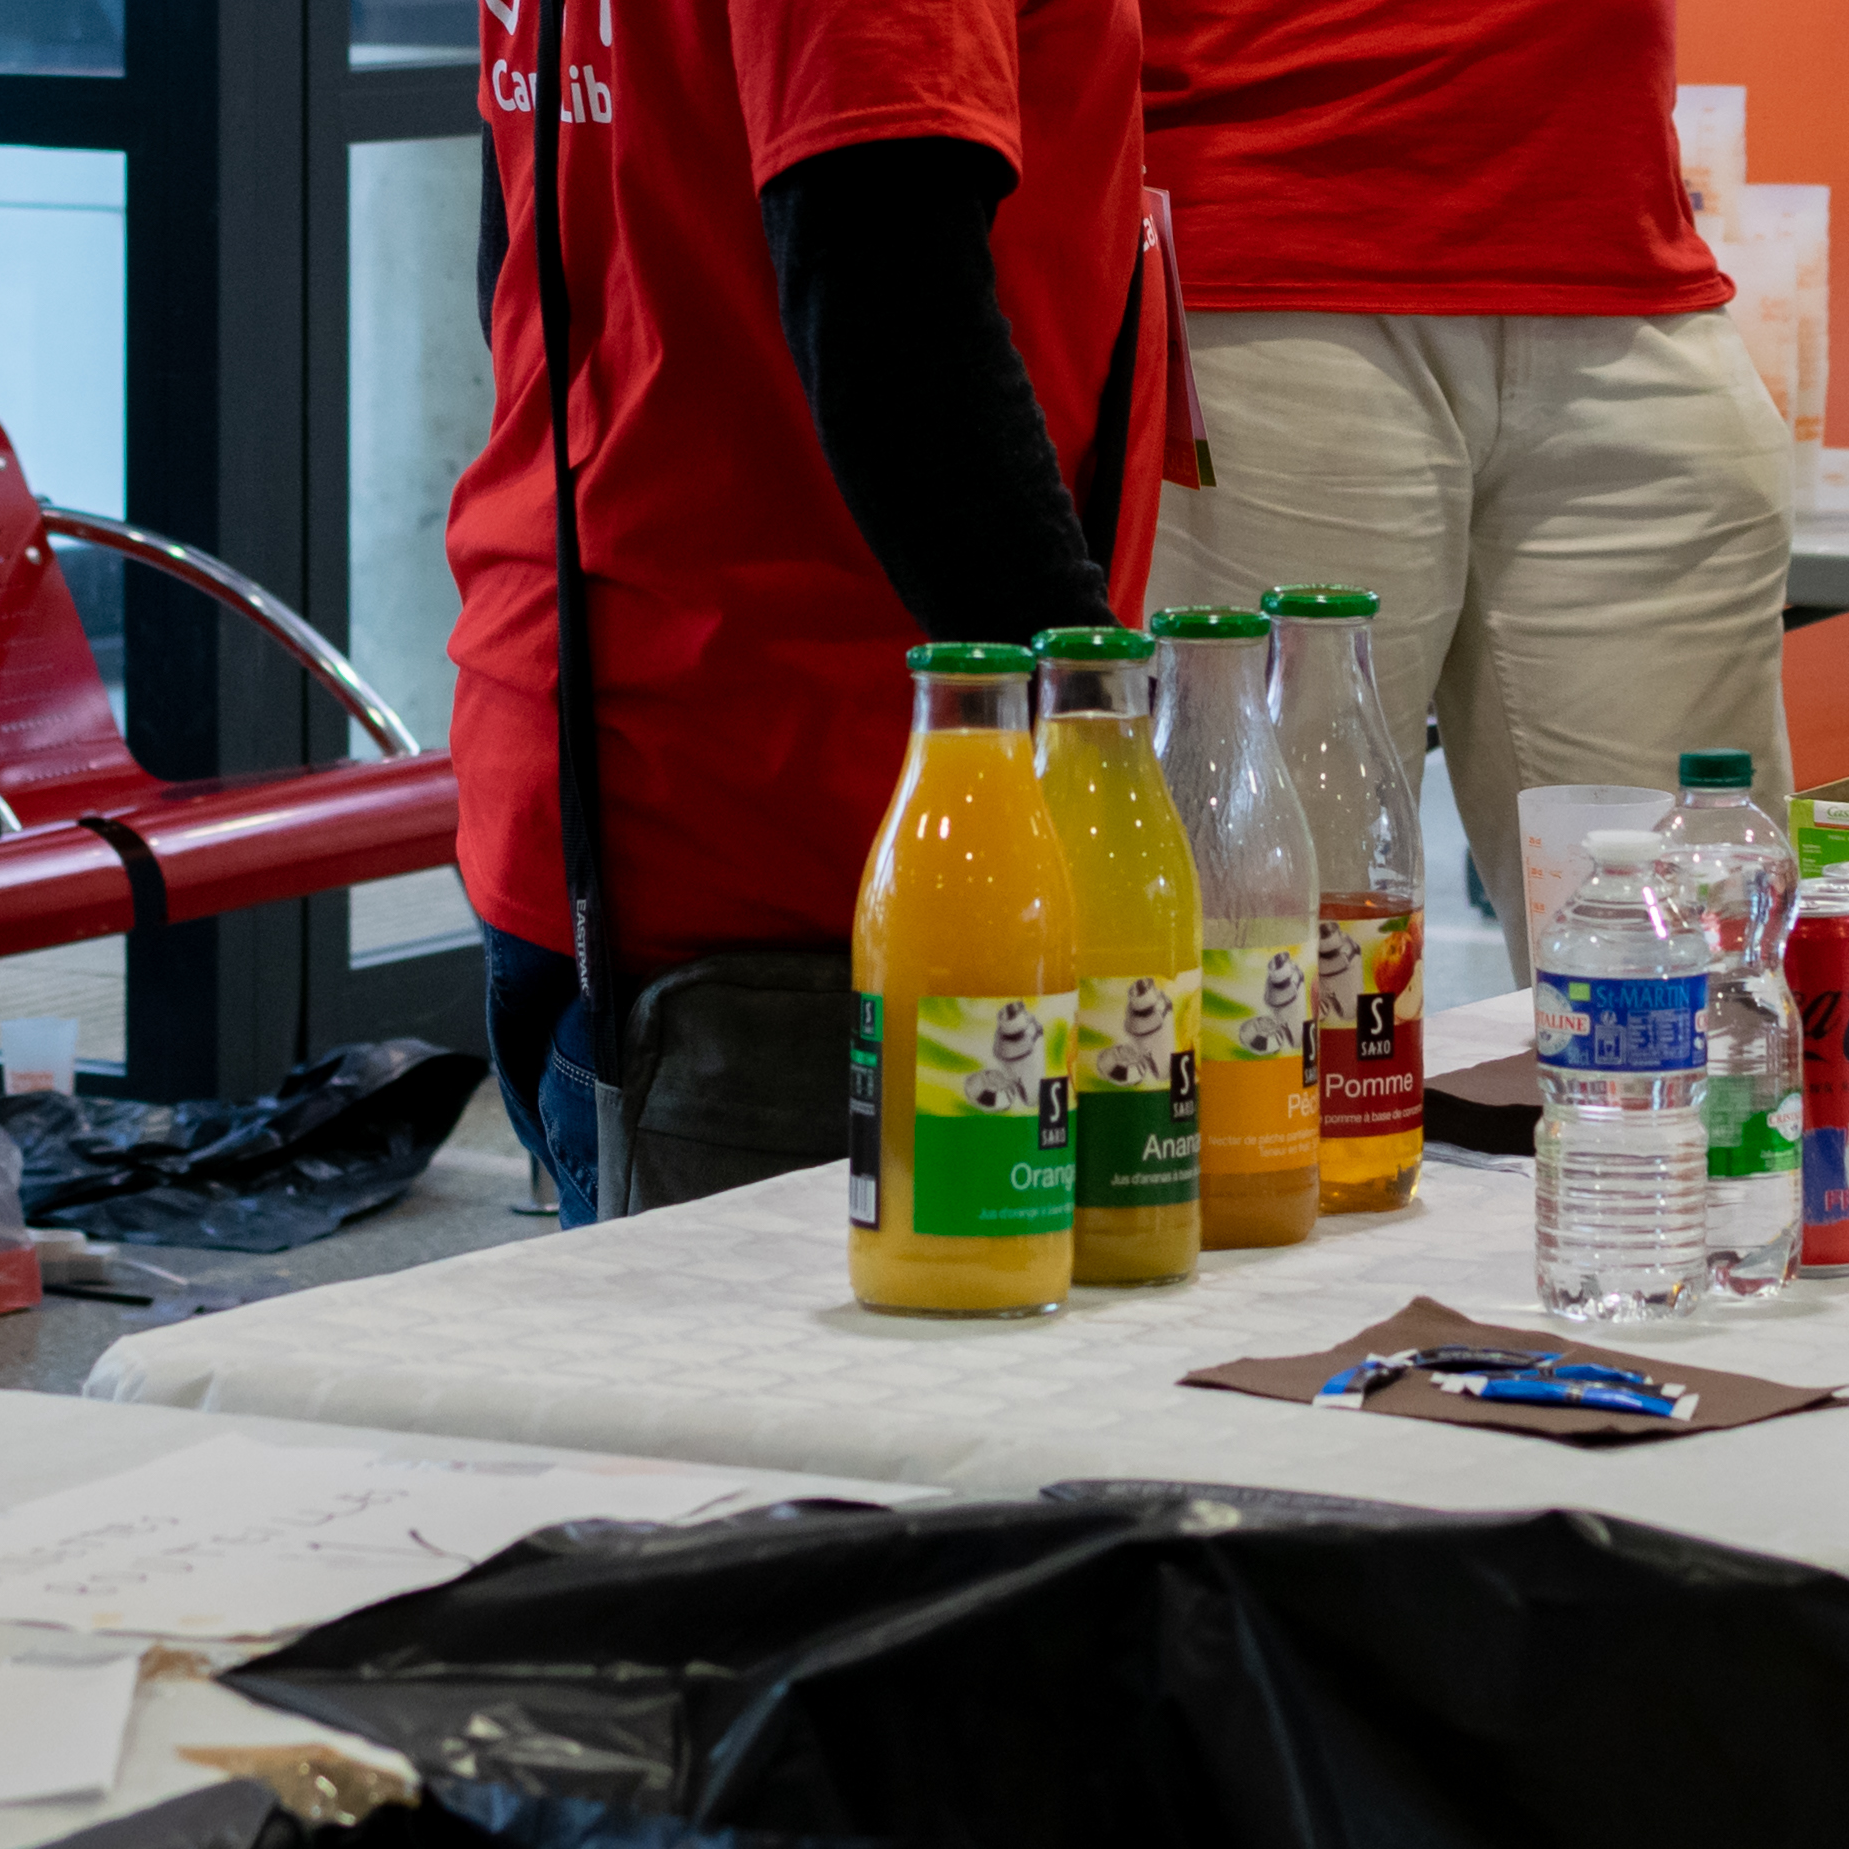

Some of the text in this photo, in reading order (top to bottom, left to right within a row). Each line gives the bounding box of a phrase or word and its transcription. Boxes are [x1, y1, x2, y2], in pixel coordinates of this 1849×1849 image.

[1370, 997, 1384, 1036] S
[1361, 1040, 1392, 1057] SAXO
[1325, 1071, 1414, 1099] Pomme
[1288, 1093, 1319, 1119] Pêc
[1324, 1111, 1362, 1126] pomme
[1010, 1161, 1076, 1192] Orang
